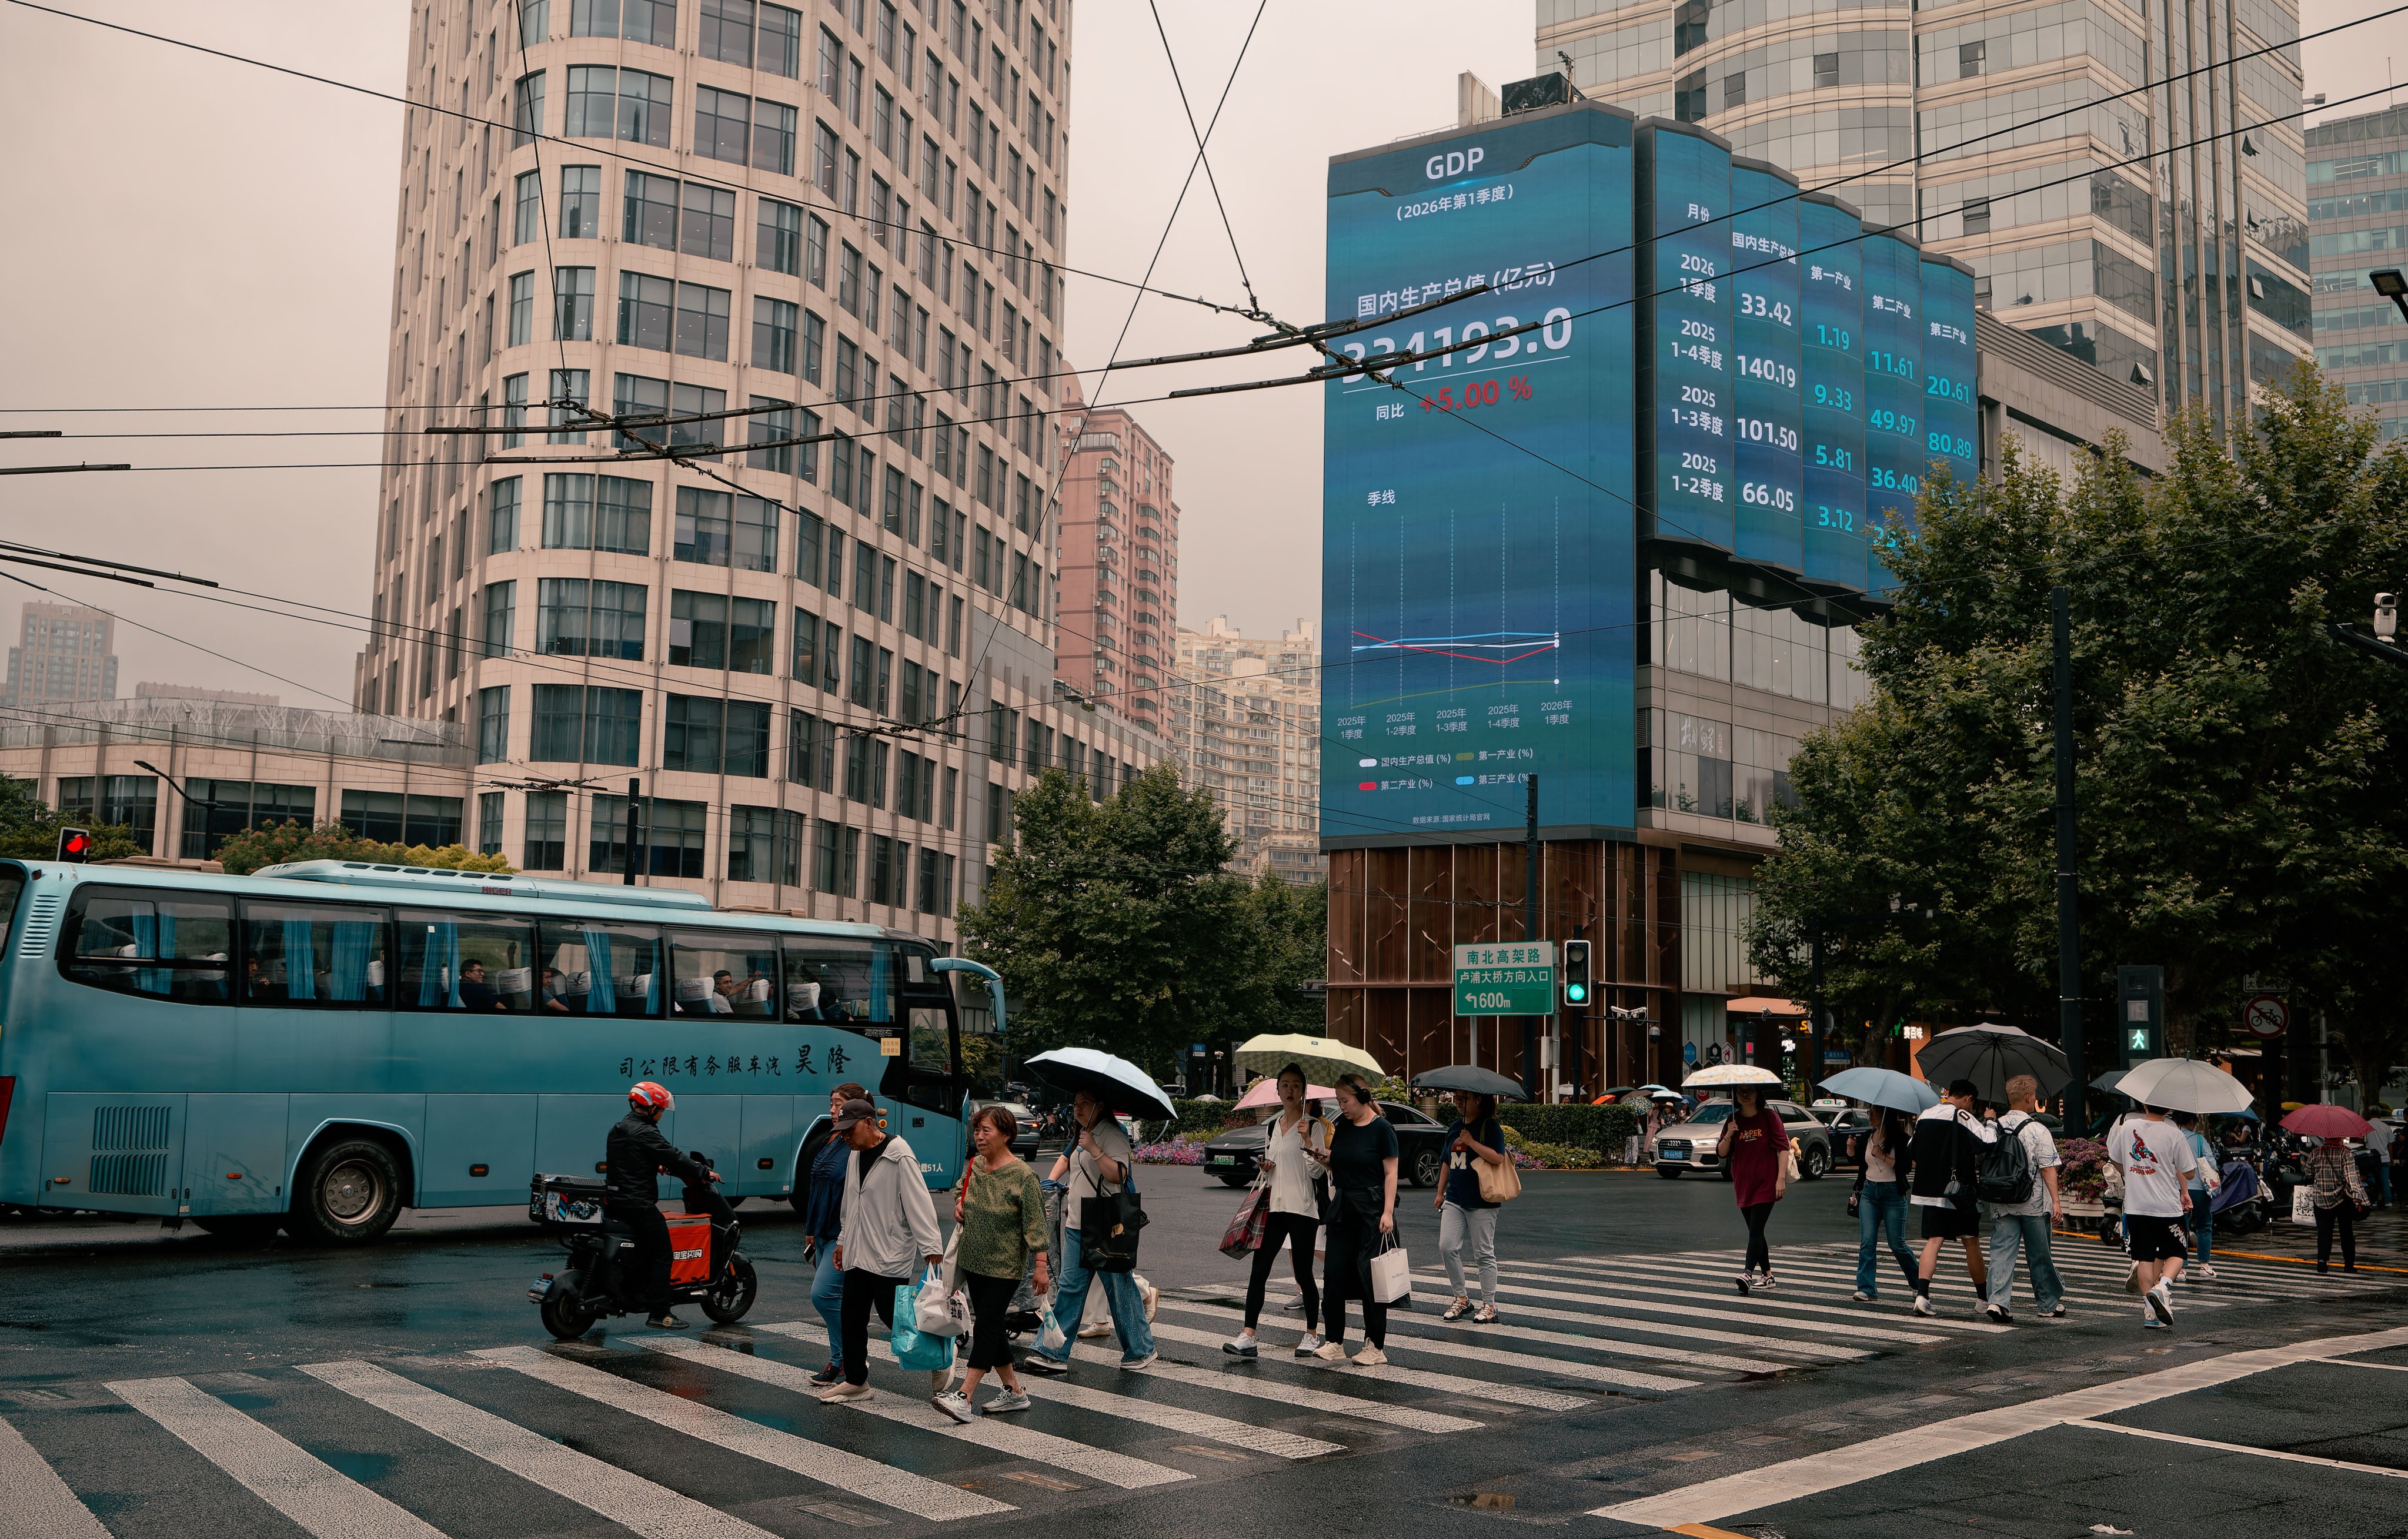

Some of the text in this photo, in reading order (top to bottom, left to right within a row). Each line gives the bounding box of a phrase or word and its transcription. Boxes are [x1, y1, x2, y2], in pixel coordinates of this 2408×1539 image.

[1426, 147, 1484, 179] GDP
[1688, 203, 1710, 222] 月份
[1732, 232, 1796, 265] 国内生产总值
[1681, 254, 1715, 277] 2026
[1811, 265, 1852, 291] 第一产业
[1357, 262, 1556, 317] 国内生产总值 (亿元)
[1679, 277, 1716, 303] 1季度
[1741, 293, 1792, 326] 33.42
[1872, 295, 1911, 319] 第二产业
[1681, 320, 1715, 342] 2025
[1816, 324, 1850, 350] 1.19
[1930, 322, 1967, 345] 第三产业
[1342, 307, 1572, 384] 334193.0
[1671, 342, 1723, 372] 1-4季度
[1871, 350, 1913, 380] 11.61
[1737, 355, 1796, 388] 140.19
[1419, 375, 1532, 413] +5.00 %
[1681, 386, 1716, 408] 2025
[1814, 384, 1852, 411] 9.33
[1928, 375, 1970, 404] 20.61
[1376, 403, 1405, 421] 同比
[1672, 408, 1723, 437] 1-3季度
[1871, 409, 1916, 437] 49.97
[1737, 417, 1797, 451] 101.50
[1928, 432, 1972, 460] 80.89
[1682, 452, 1716, 474] 2025
[1816, 445, 1852, 471] 5.81
[1672, 476, 1724, 503] 1-2季度
[1872, 467, 1918, 496] 36.40
[1367, 489, 1395, 506] 季线
[1742, 482, 1794, 513] 66.05
[1818, 506, 1853, 533] 3.12
[1437, 708, 1467, 721] 2025年
[1488, 704, 1519, 716] 2025年
[1541, 700, 1573, 712] 2026年
[1337, 715, 1366, 727] 2025年
[1386, 712, 1416, 724] 2025年
[1436, 721, 1468, 732] 1-3季度
[1487, 717, 1520, 730] 1-4季度
[1544, 712, 1569, 725] 1季度
[1341, 728, 1363, 740] 1季度
[1385, 724, 1417, 736] 1-2季度
[1381, 753, 1451, 768] 国内生产总值 (%)
[1478, 748, 1534, 761] 第一产业 (%)
[1381, 778, 1433, 791] 第二产业 (%)
[1478, 772, 1516, 785] 第三产业
[1412, 812, 1490, 824] 数据来源:国家统计局官网
[482, 886, 512, 895] HIGER
[1467, 948, 1540, 965] 南北高架路
[1460, 971, 1548, 984] 卢浦大桥方向入口
[1479, 992, 1511, 1008] 600m
[1903, 1026, 1923, 1040] 赛百味
[920, 1163, 943, 1173] 载51人
[1450, 1152, 1467, 1169] M
